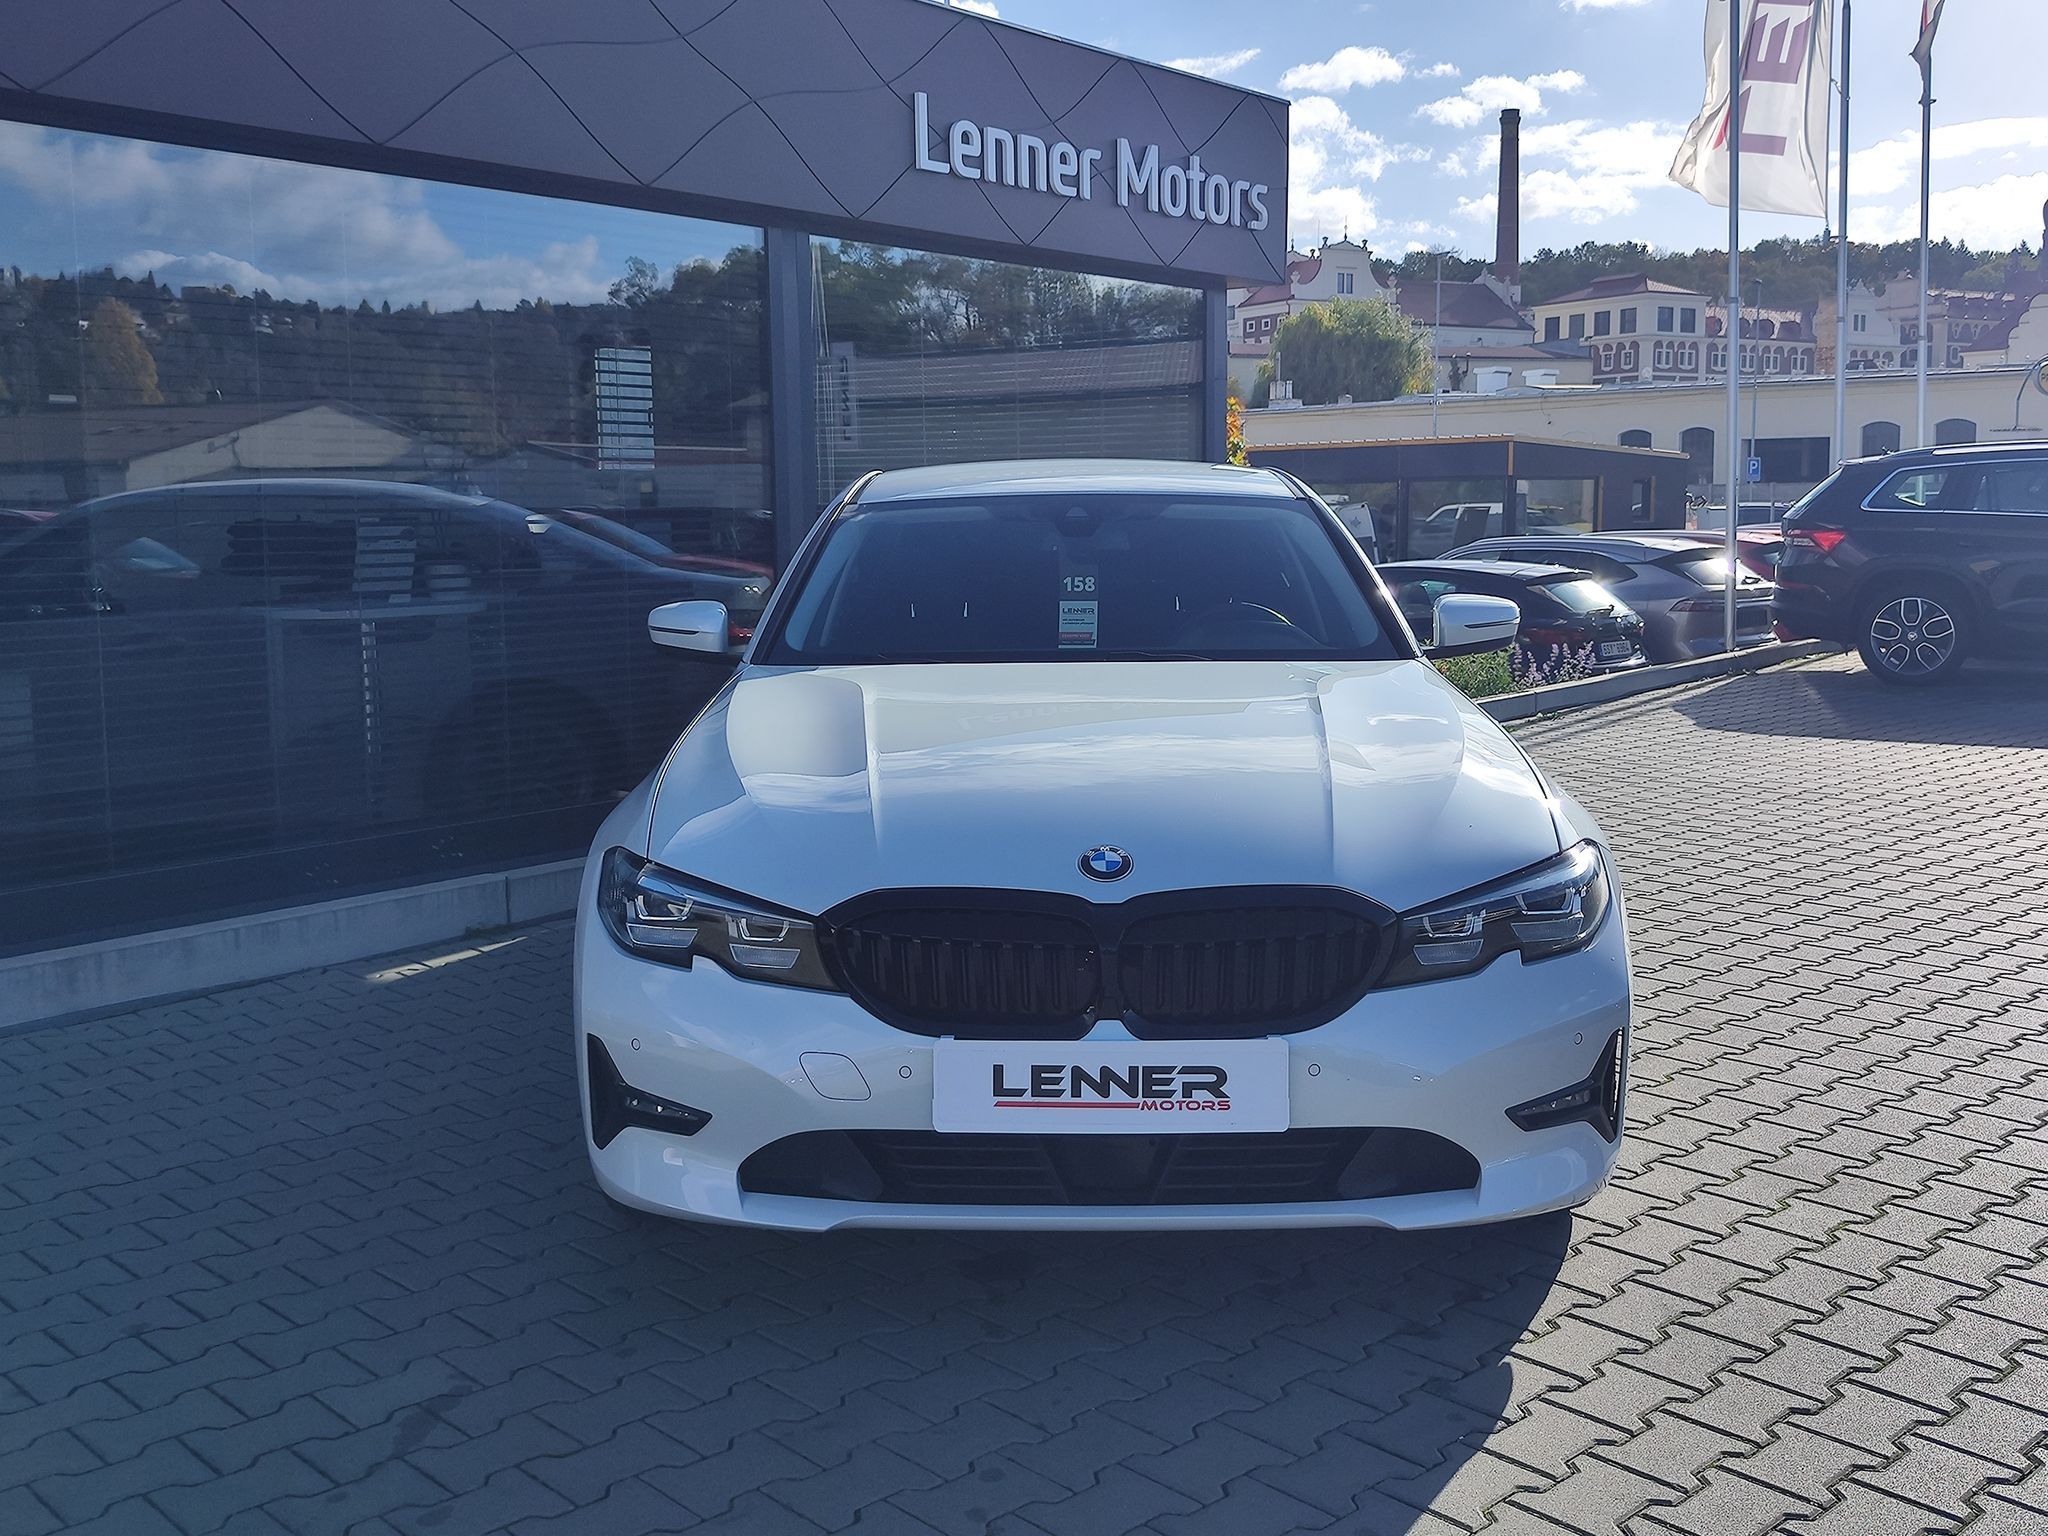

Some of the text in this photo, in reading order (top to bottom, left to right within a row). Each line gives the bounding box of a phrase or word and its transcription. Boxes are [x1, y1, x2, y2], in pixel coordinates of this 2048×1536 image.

[913, 92, 1269, 231] Lenner Motors
[1749, 461, 1758, 474] P
[1063, 576, 1096, 592] 158
[993, 1064, 1231, 1099] LENNER
[1140, 1100, 1231, 1111] MOTORS
